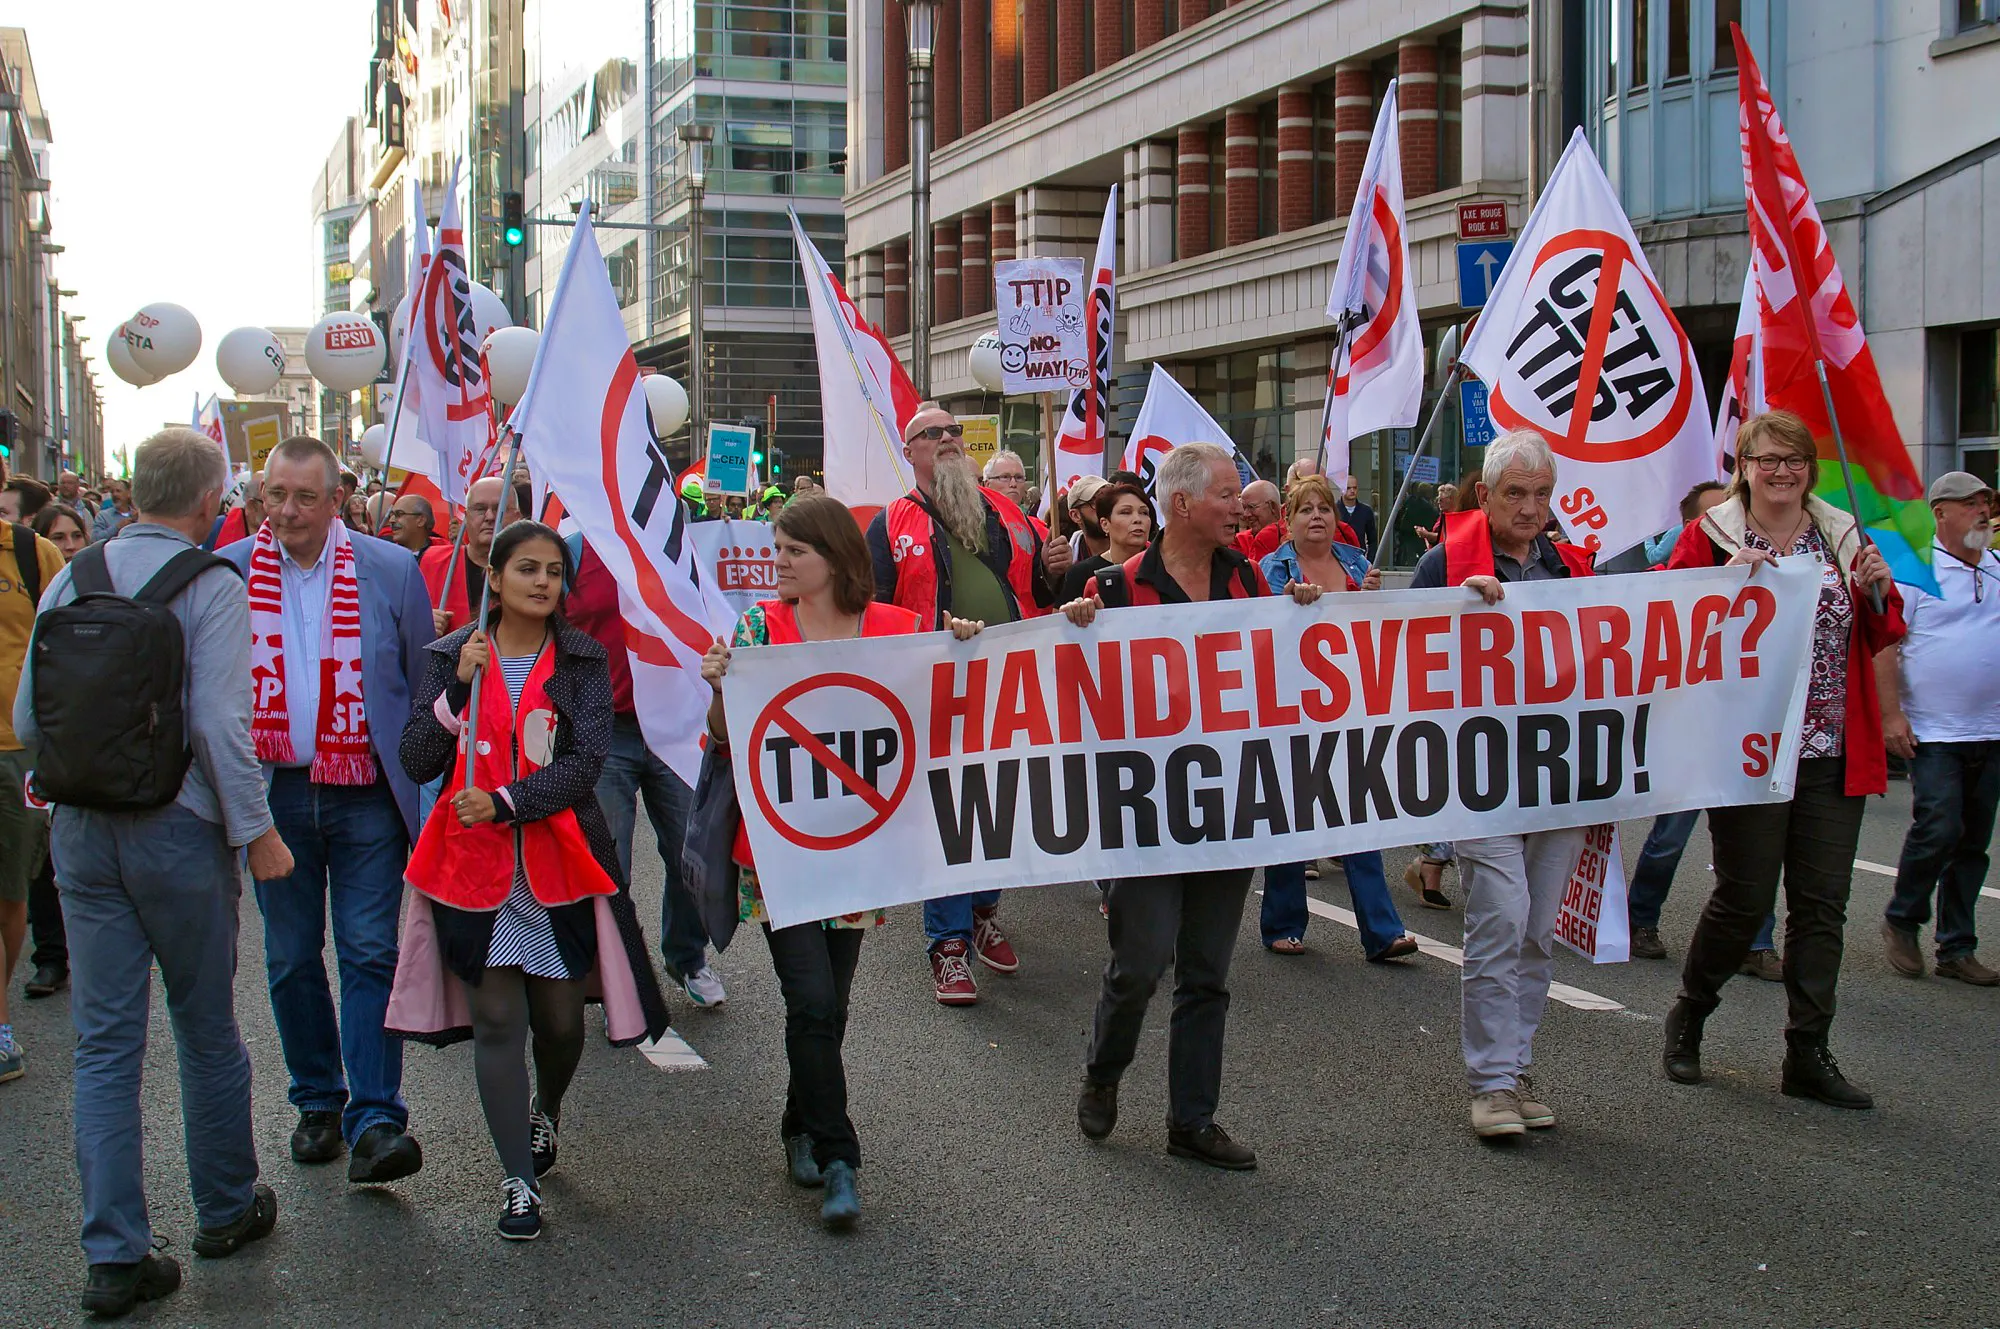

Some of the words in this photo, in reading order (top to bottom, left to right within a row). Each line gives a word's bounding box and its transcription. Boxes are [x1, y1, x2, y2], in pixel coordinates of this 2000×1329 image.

[1463, 209, 1478, 220] AXE
[1480, 207, 1503, 219] ROUGE
[1468, 221, 1487, 232] RODE
[1490, 221, 1500, 230] AS
[1008, 278, 1071, 307] TTIP
[135, 311, 160, 328] TOP
[330, 330, 371, 347] EPSU
[1548, 253, 1676, 421] CETA
[264, 345, 285, 376] CET
[1068, 365, 1089, 380] TTIP
[1505, 297, 1618, 423] TTIP
[1477, 430, 1490, 442] 13
[1478, 417, 1486, 428] 7
[720, 454, 746, 466] CETA
[970, 442, 995, 451] CETA
[1560, 486, 1608, 530] SP
[893, 534, 913, 563] SP
[725, 563, 778, 586] EPSU
[929, 585, 1778, 759] HANDELSVERDRAG?
[331, 702, 366, 733] SP
[765, 727, 898, 804] TTIP
[928, 703, 1652, 866] WURGAKKOORD!
[1574, 848, 1598, 884] EG
